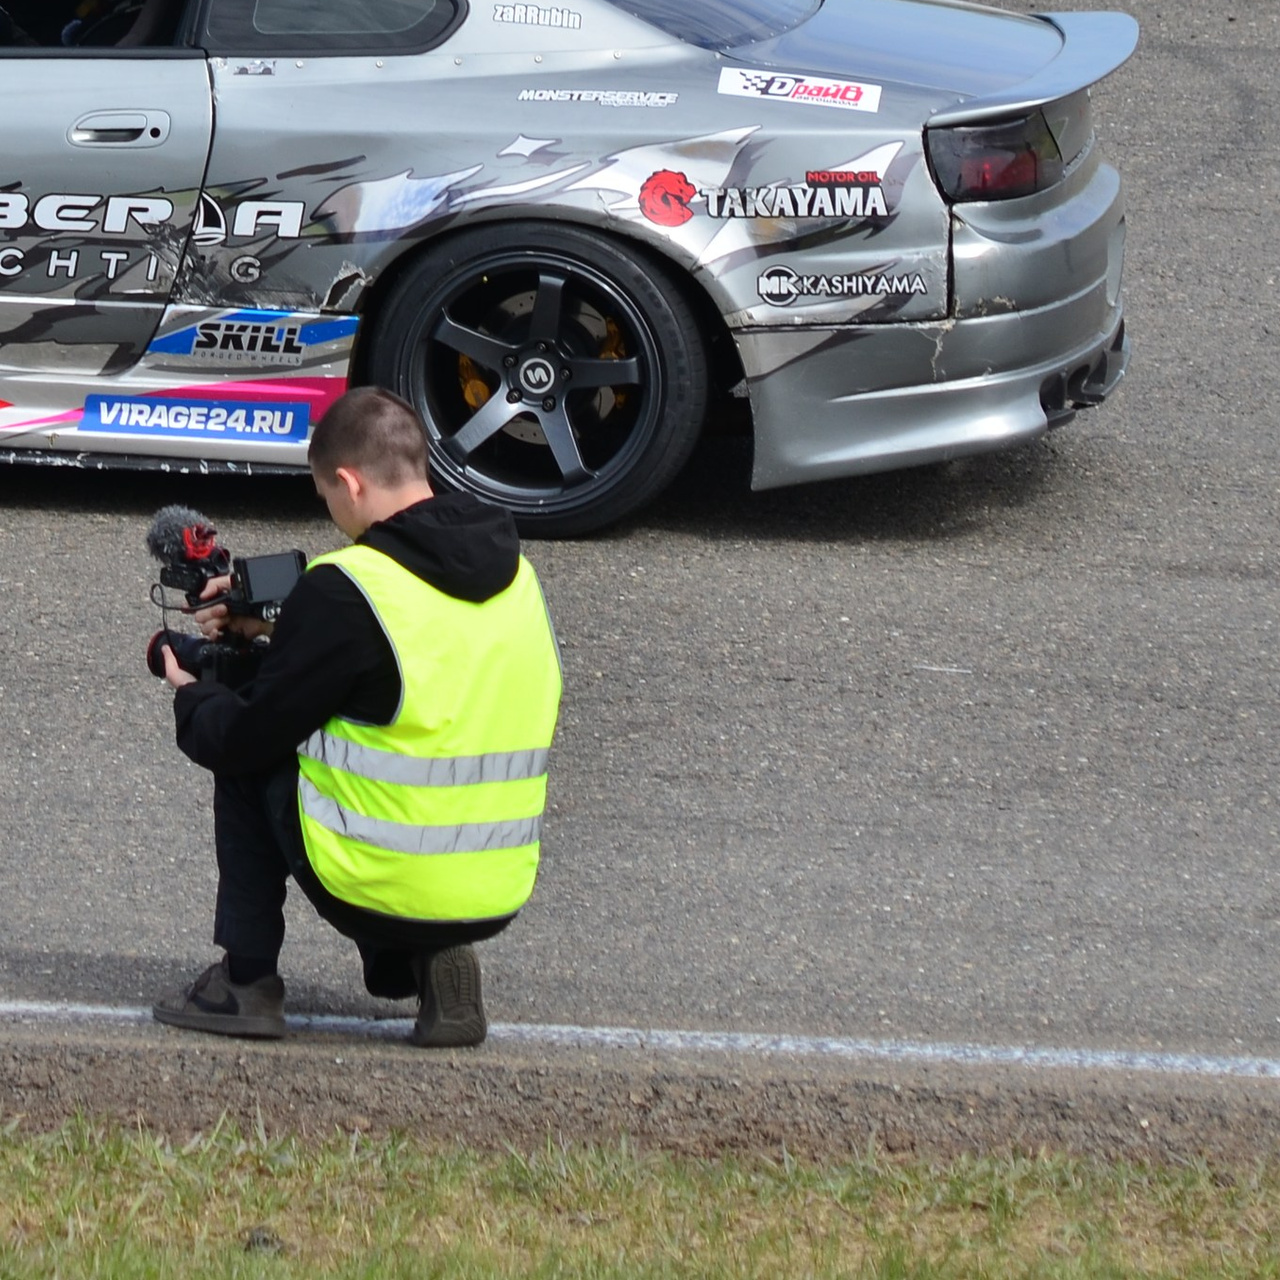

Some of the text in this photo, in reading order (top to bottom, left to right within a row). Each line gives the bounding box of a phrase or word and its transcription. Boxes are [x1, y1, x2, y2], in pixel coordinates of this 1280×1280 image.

[517, 89, 679, 104] MONSTERSERVICE
[807, 171, 880, 183] MOTOR OIL
[698, 186, 891, 218] TAKAYAMA
[801, 275, 926, 295] KASHIYAMA
[195, 322, 303, 355] SKILL
[99, 401, 293, 435] VIRAGE24.RU
